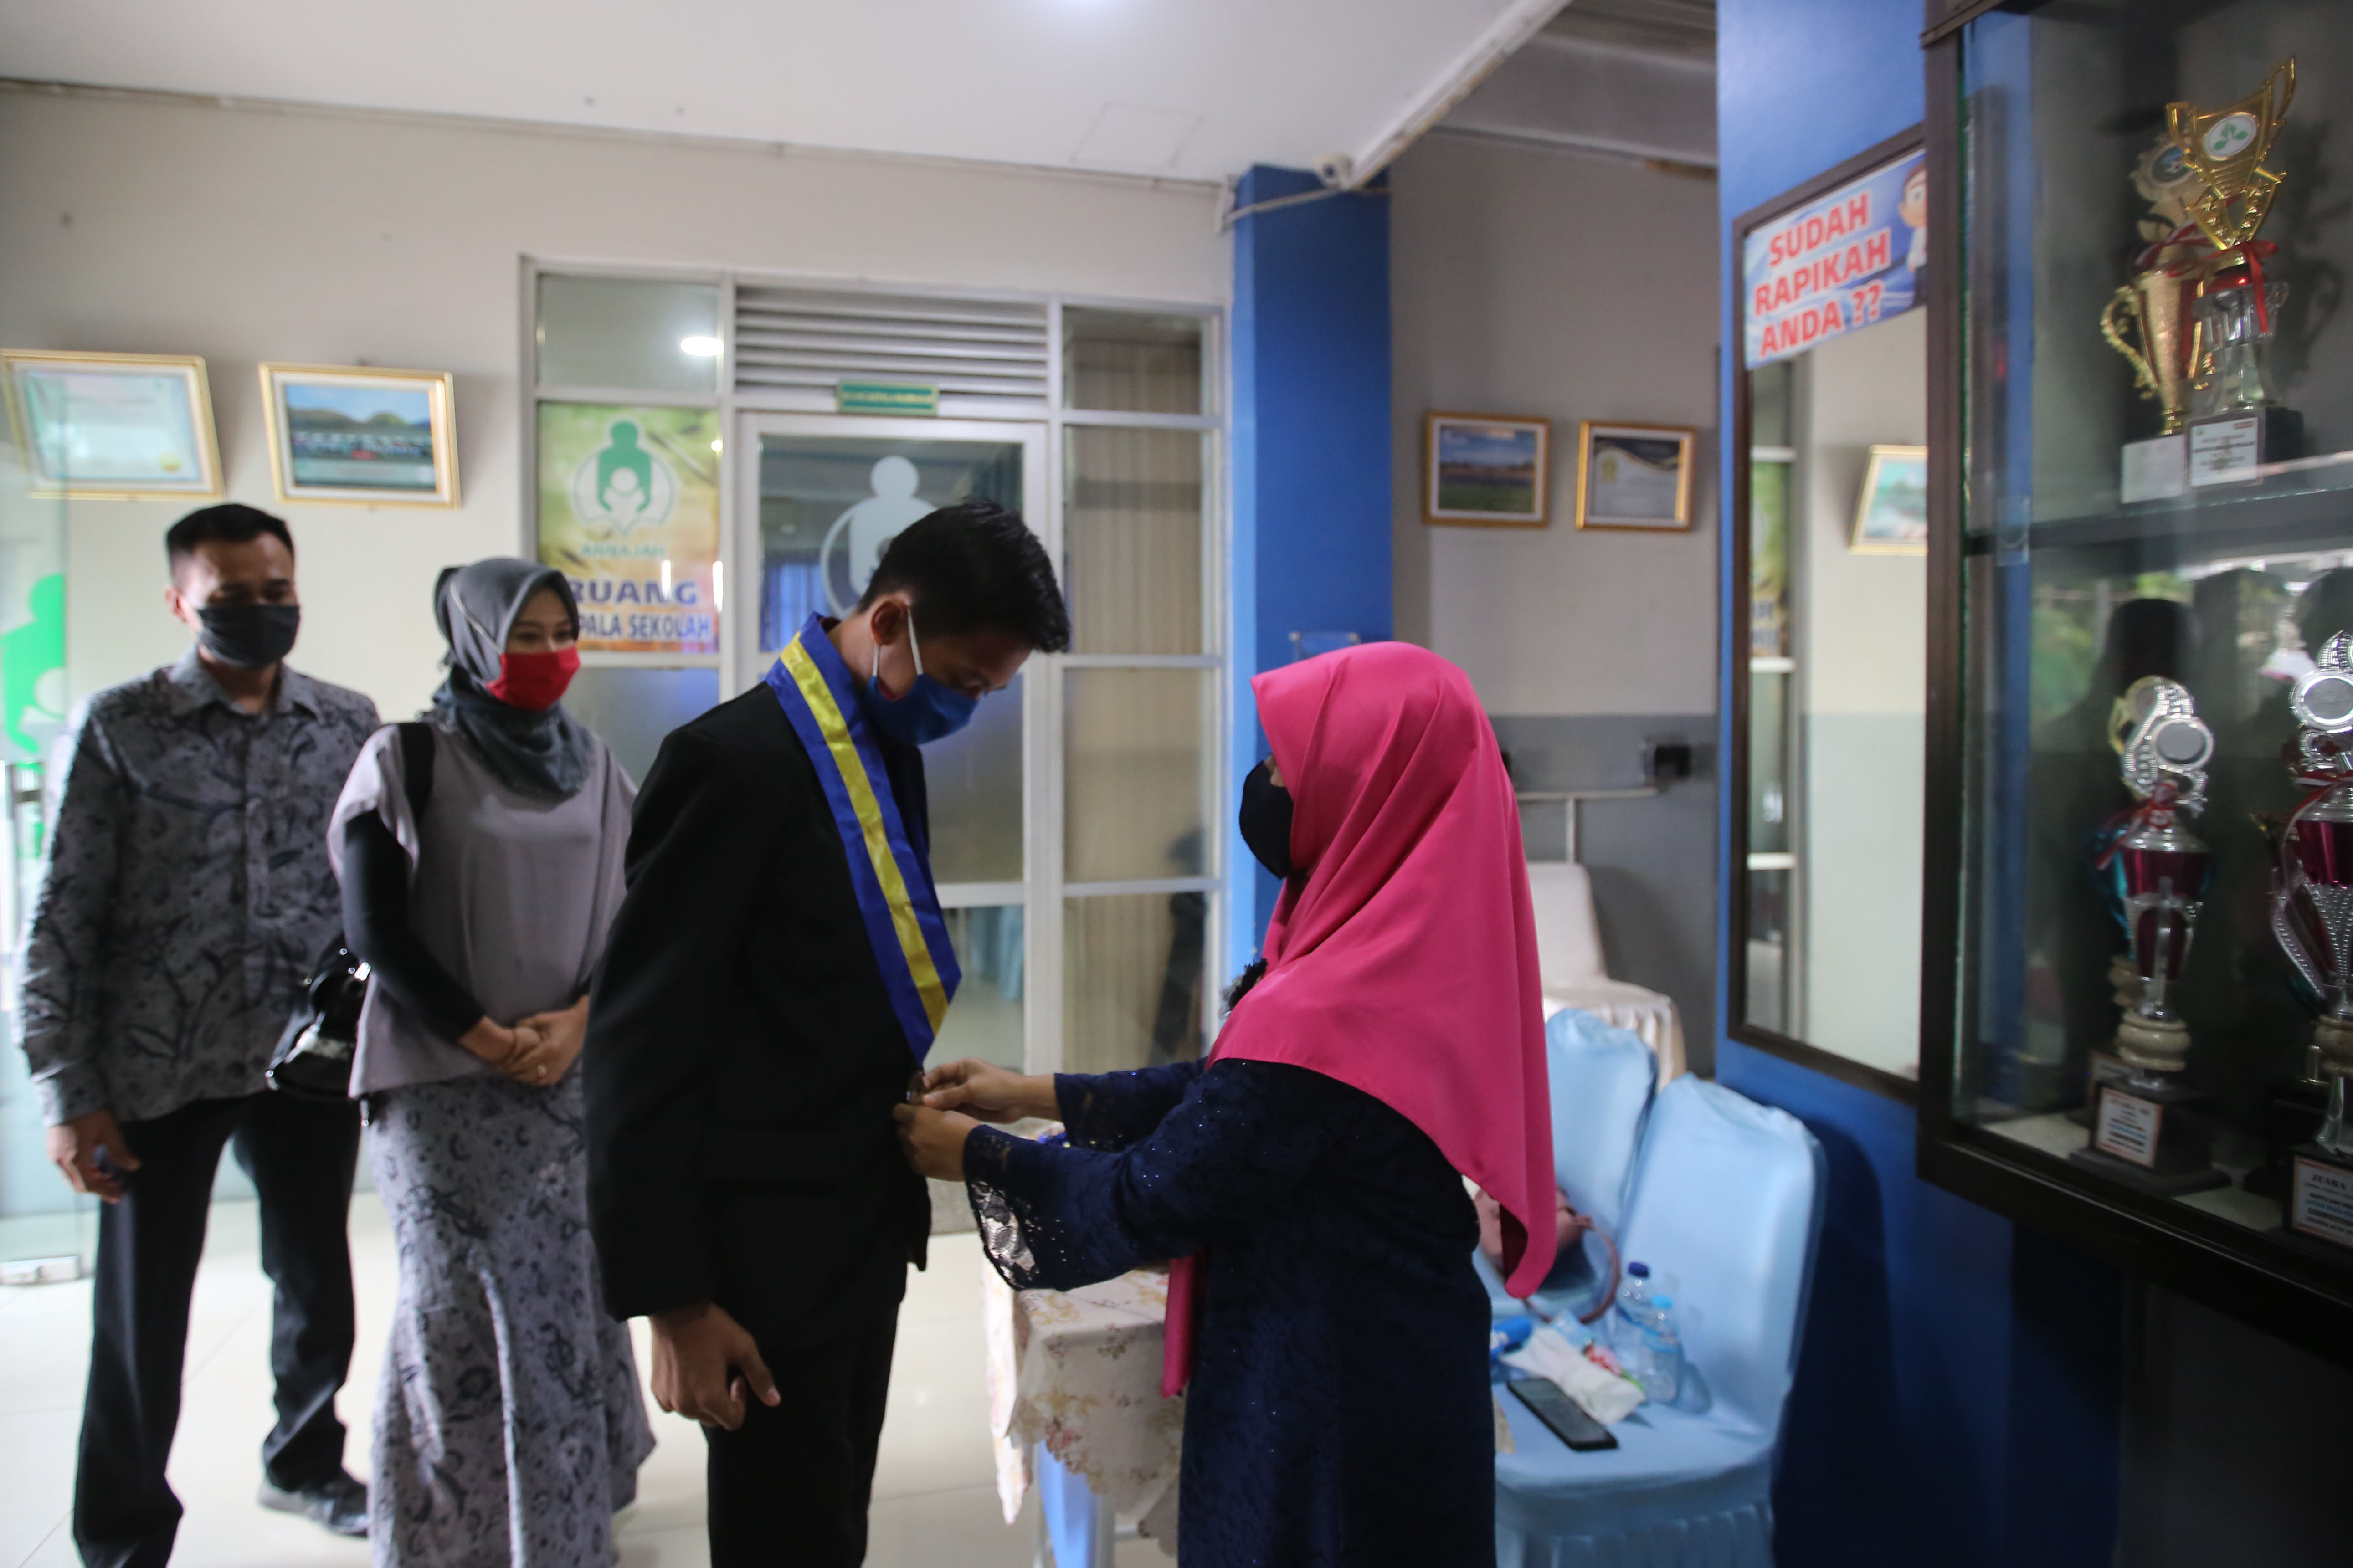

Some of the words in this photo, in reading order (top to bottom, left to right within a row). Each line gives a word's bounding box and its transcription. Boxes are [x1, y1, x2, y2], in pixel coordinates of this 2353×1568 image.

[1770, 194, 1868, 266] SUDAH
[1755, 231, 1889, 316] RAPIKAH
[1760, 302, 1842, 357] ANDA
[1852, 283, 1883, 324] ??
[569, 581, 697, 605] RUANG
[629, 615, 710, 638] SEKOLAH
